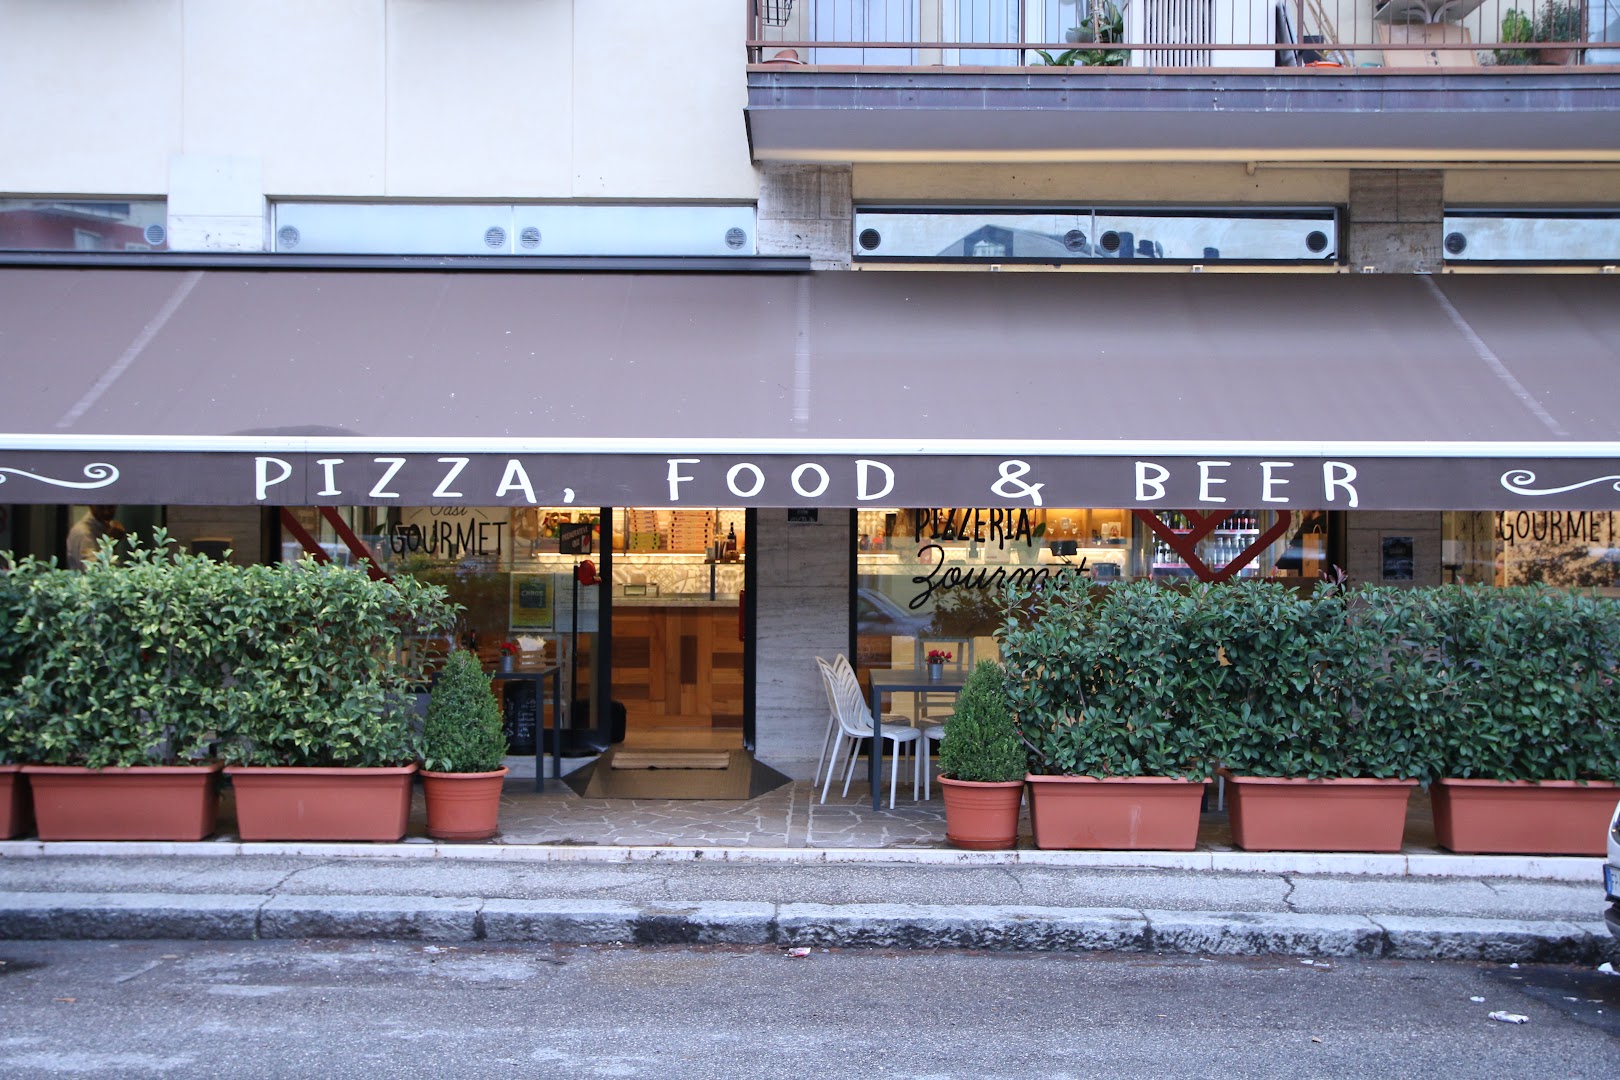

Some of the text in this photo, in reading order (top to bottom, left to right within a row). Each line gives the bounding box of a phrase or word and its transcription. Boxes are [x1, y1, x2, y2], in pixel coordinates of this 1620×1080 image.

[254, 456, 1359, 508] PIZZA, FOOD & BEER
[390, 517, 508, 560] GOURMET
[914, 507, 1033, 550] PIZZERIA
